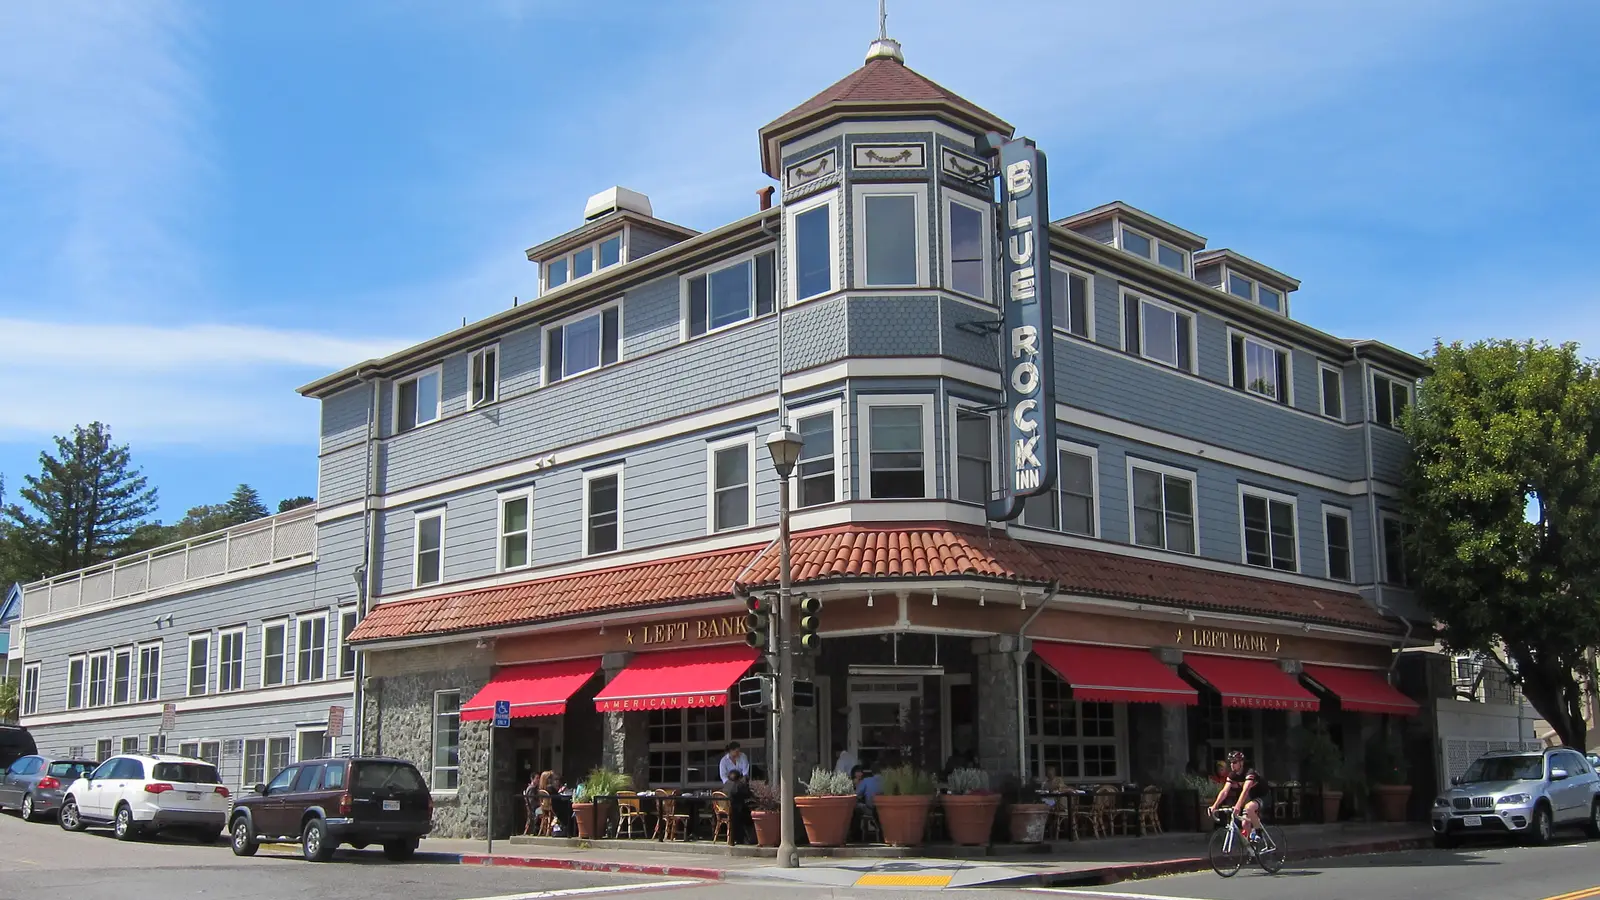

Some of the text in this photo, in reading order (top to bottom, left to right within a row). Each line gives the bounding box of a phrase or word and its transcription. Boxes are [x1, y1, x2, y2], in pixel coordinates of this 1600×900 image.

[1007, 159, 1041, 470] BLUE ROCK
[1015, 469, 1040, 490] INN
[643, 615, 748, 644] LEFT BANK
[1192, 629, 1268, 652] LEFT BANK
[603, 695, 716, 709] AMERICAN BAR
[1232, 697, 1312, 709] AMERICAN BAR
